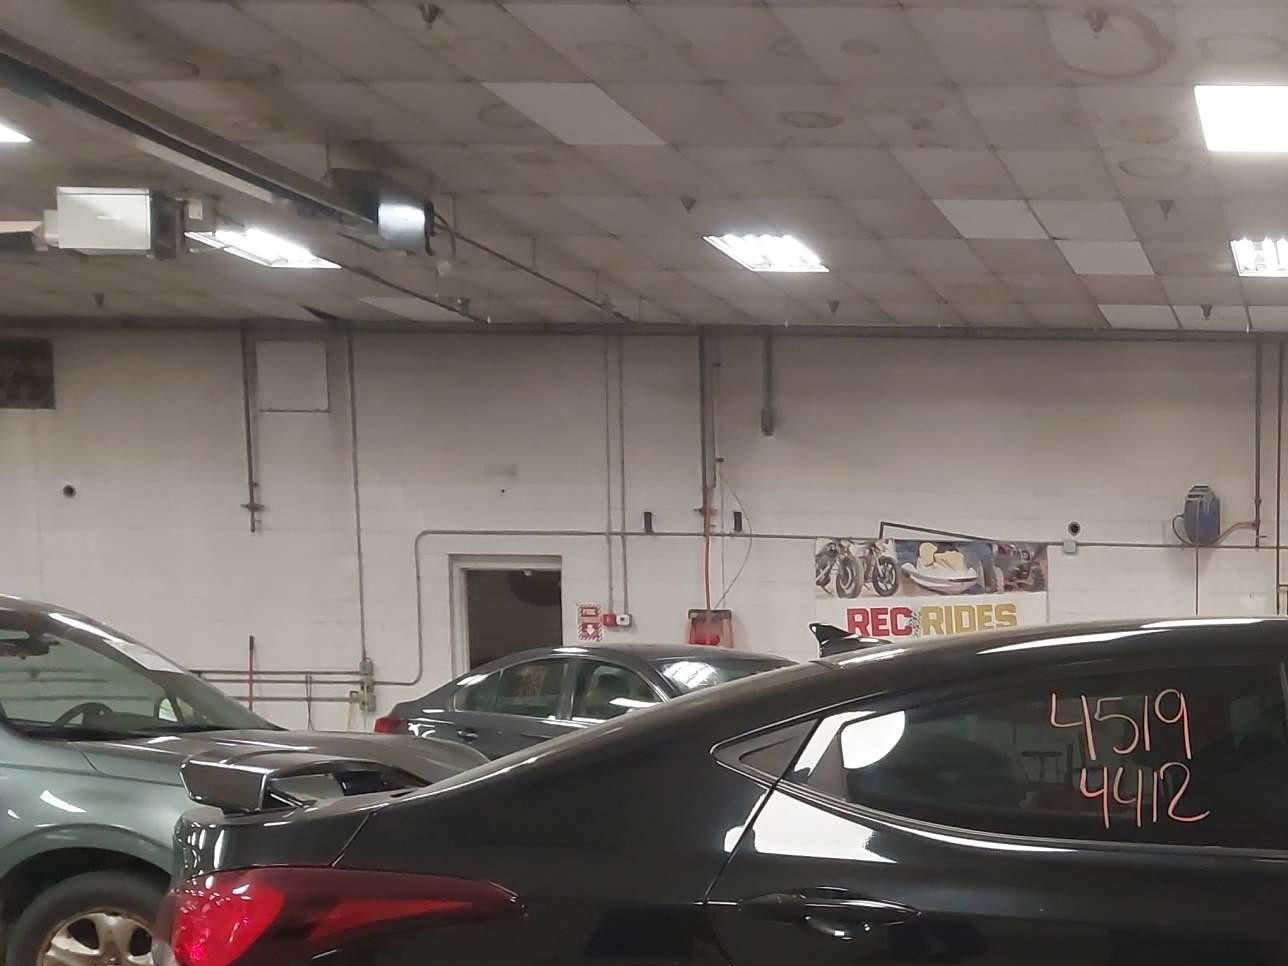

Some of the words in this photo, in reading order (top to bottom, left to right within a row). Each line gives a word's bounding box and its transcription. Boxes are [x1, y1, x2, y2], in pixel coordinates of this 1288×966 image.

[846, 606, 913, 637] REC
[919, 602, 1018, 636] RIDES
[1050, 688, 1192, 760] 4519
[1079, 761, 1211, 829] 4412
